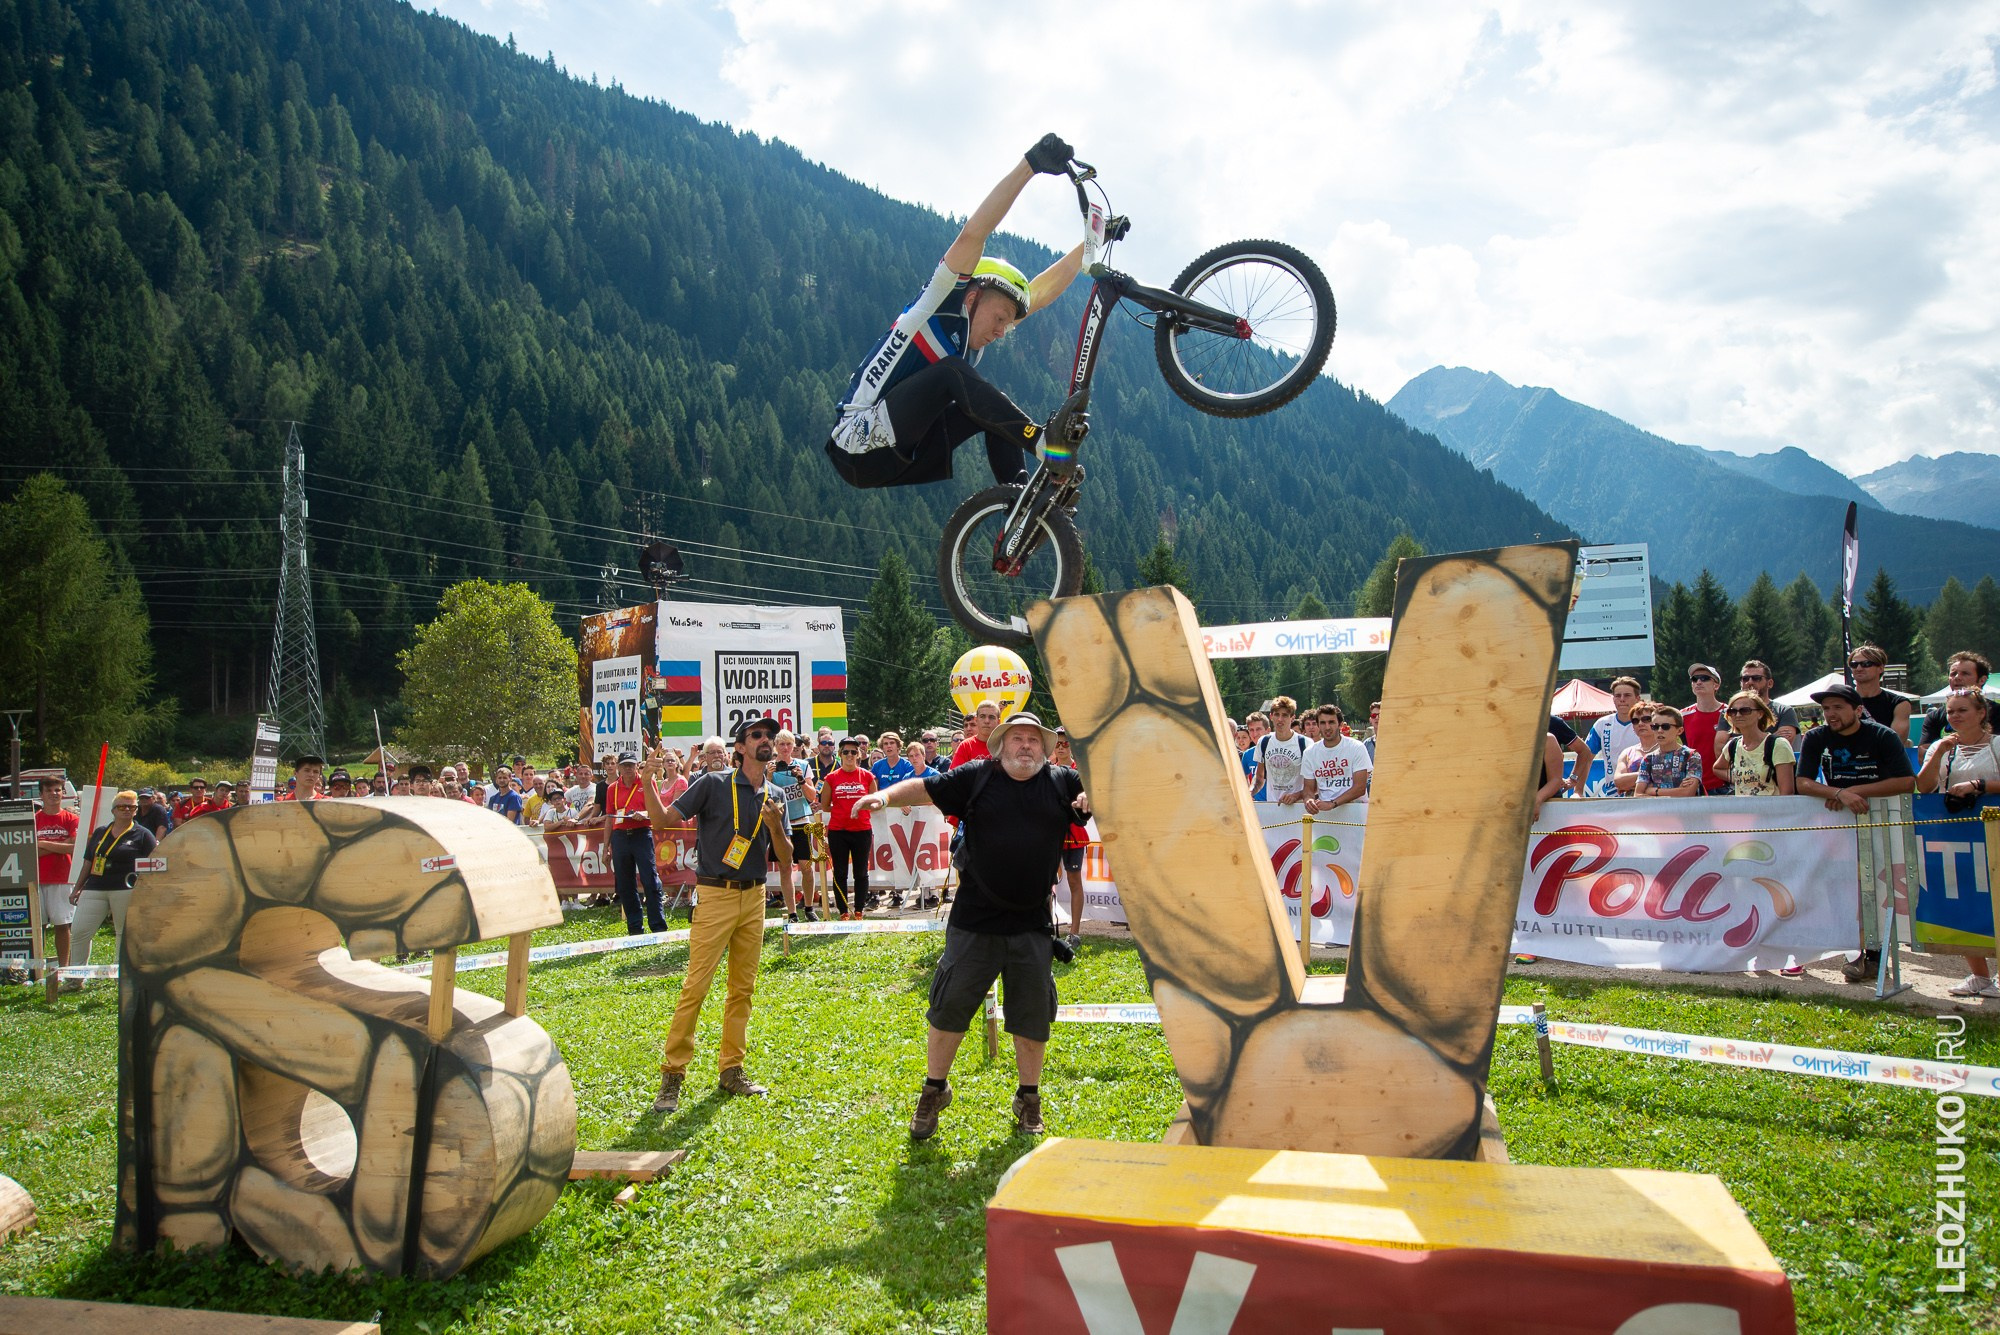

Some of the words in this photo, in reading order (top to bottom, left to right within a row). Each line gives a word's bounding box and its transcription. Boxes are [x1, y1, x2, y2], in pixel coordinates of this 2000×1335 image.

[865, 329, 909, 390] FRANCE
[724, 657, 736, 665] UCI
[738, 657, 775, 665] MOUNTAIN
[777, 657, 791, 665] BIKE
[723, 669, 792, 689] WORLD
[971, 674, 992, 691] Val
[993, 679, 1002, 688] di
[726, 694, 792, 704] CHAMPIONSHIPS
[595, 698, 636, 734] 2017
[1266, 747, 1300, 762] CRANBERRY
[1603, 729, 1614, 775] FINLAND
[890, 821, 949, 876] Val
[0, 852, 23, 884] 4
[1530, 824, 1731, 922] Poli
[7, 898, 24, 907] UCI
[7, 929, 24, 938] UCI
[1552, 922, 1603, 937] TUTTI
